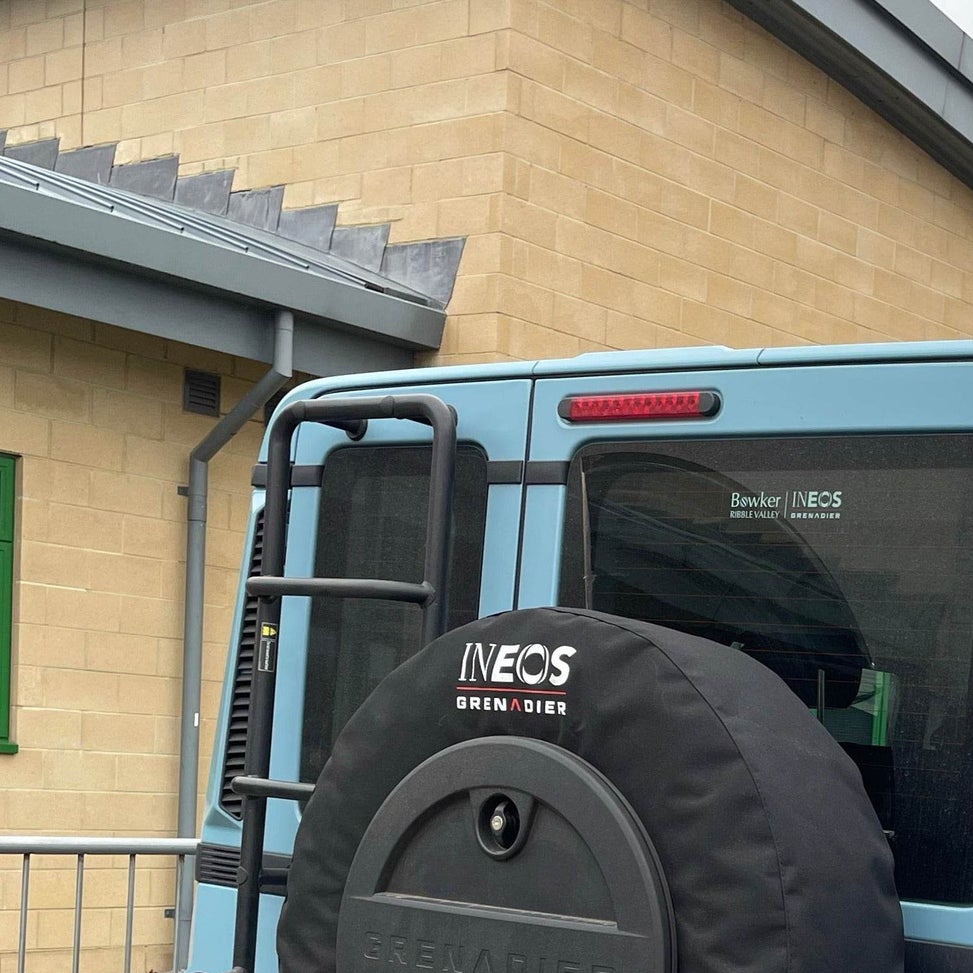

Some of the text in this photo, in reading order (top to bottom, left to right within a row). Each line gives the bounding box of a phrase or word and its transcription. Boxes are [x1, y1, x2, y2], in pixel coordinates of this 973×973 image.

[731, 491, 781, 508] Bowker
[792, 491, 842, 508] INEOS
[729, 510, 780, 519] RIBBLE VALLEY
[458, 642, 577, 686] INEOS
[456, 696, 567, 716] GRENADIER
